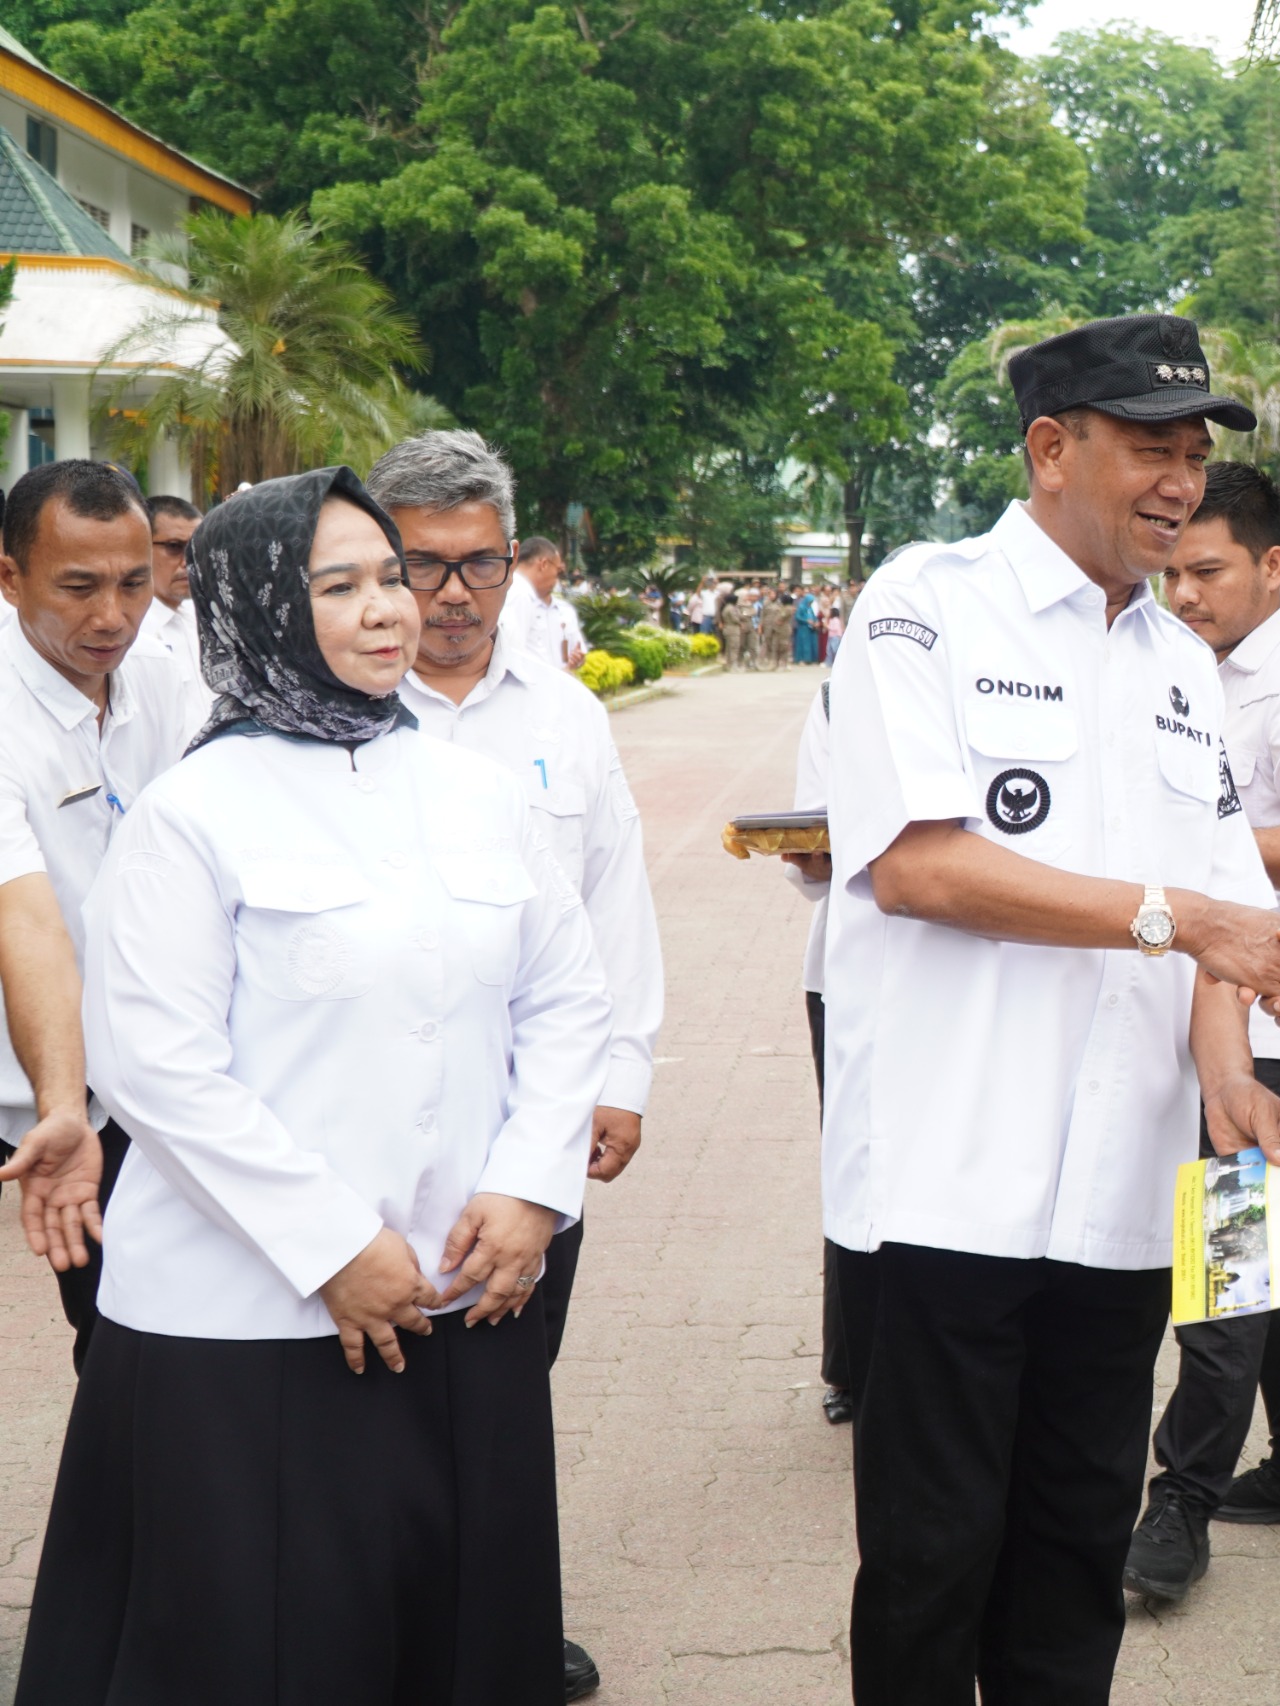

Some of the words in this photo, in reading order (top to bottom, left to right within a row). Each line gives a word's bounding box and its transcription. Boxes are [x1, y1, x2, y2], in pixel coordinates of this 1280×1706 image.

[871, 620, 935, 646] PEMPROVSU
[975, 677, 1064, 702] ONDIM
[1155, 714, 1211, 747] BUPATI
